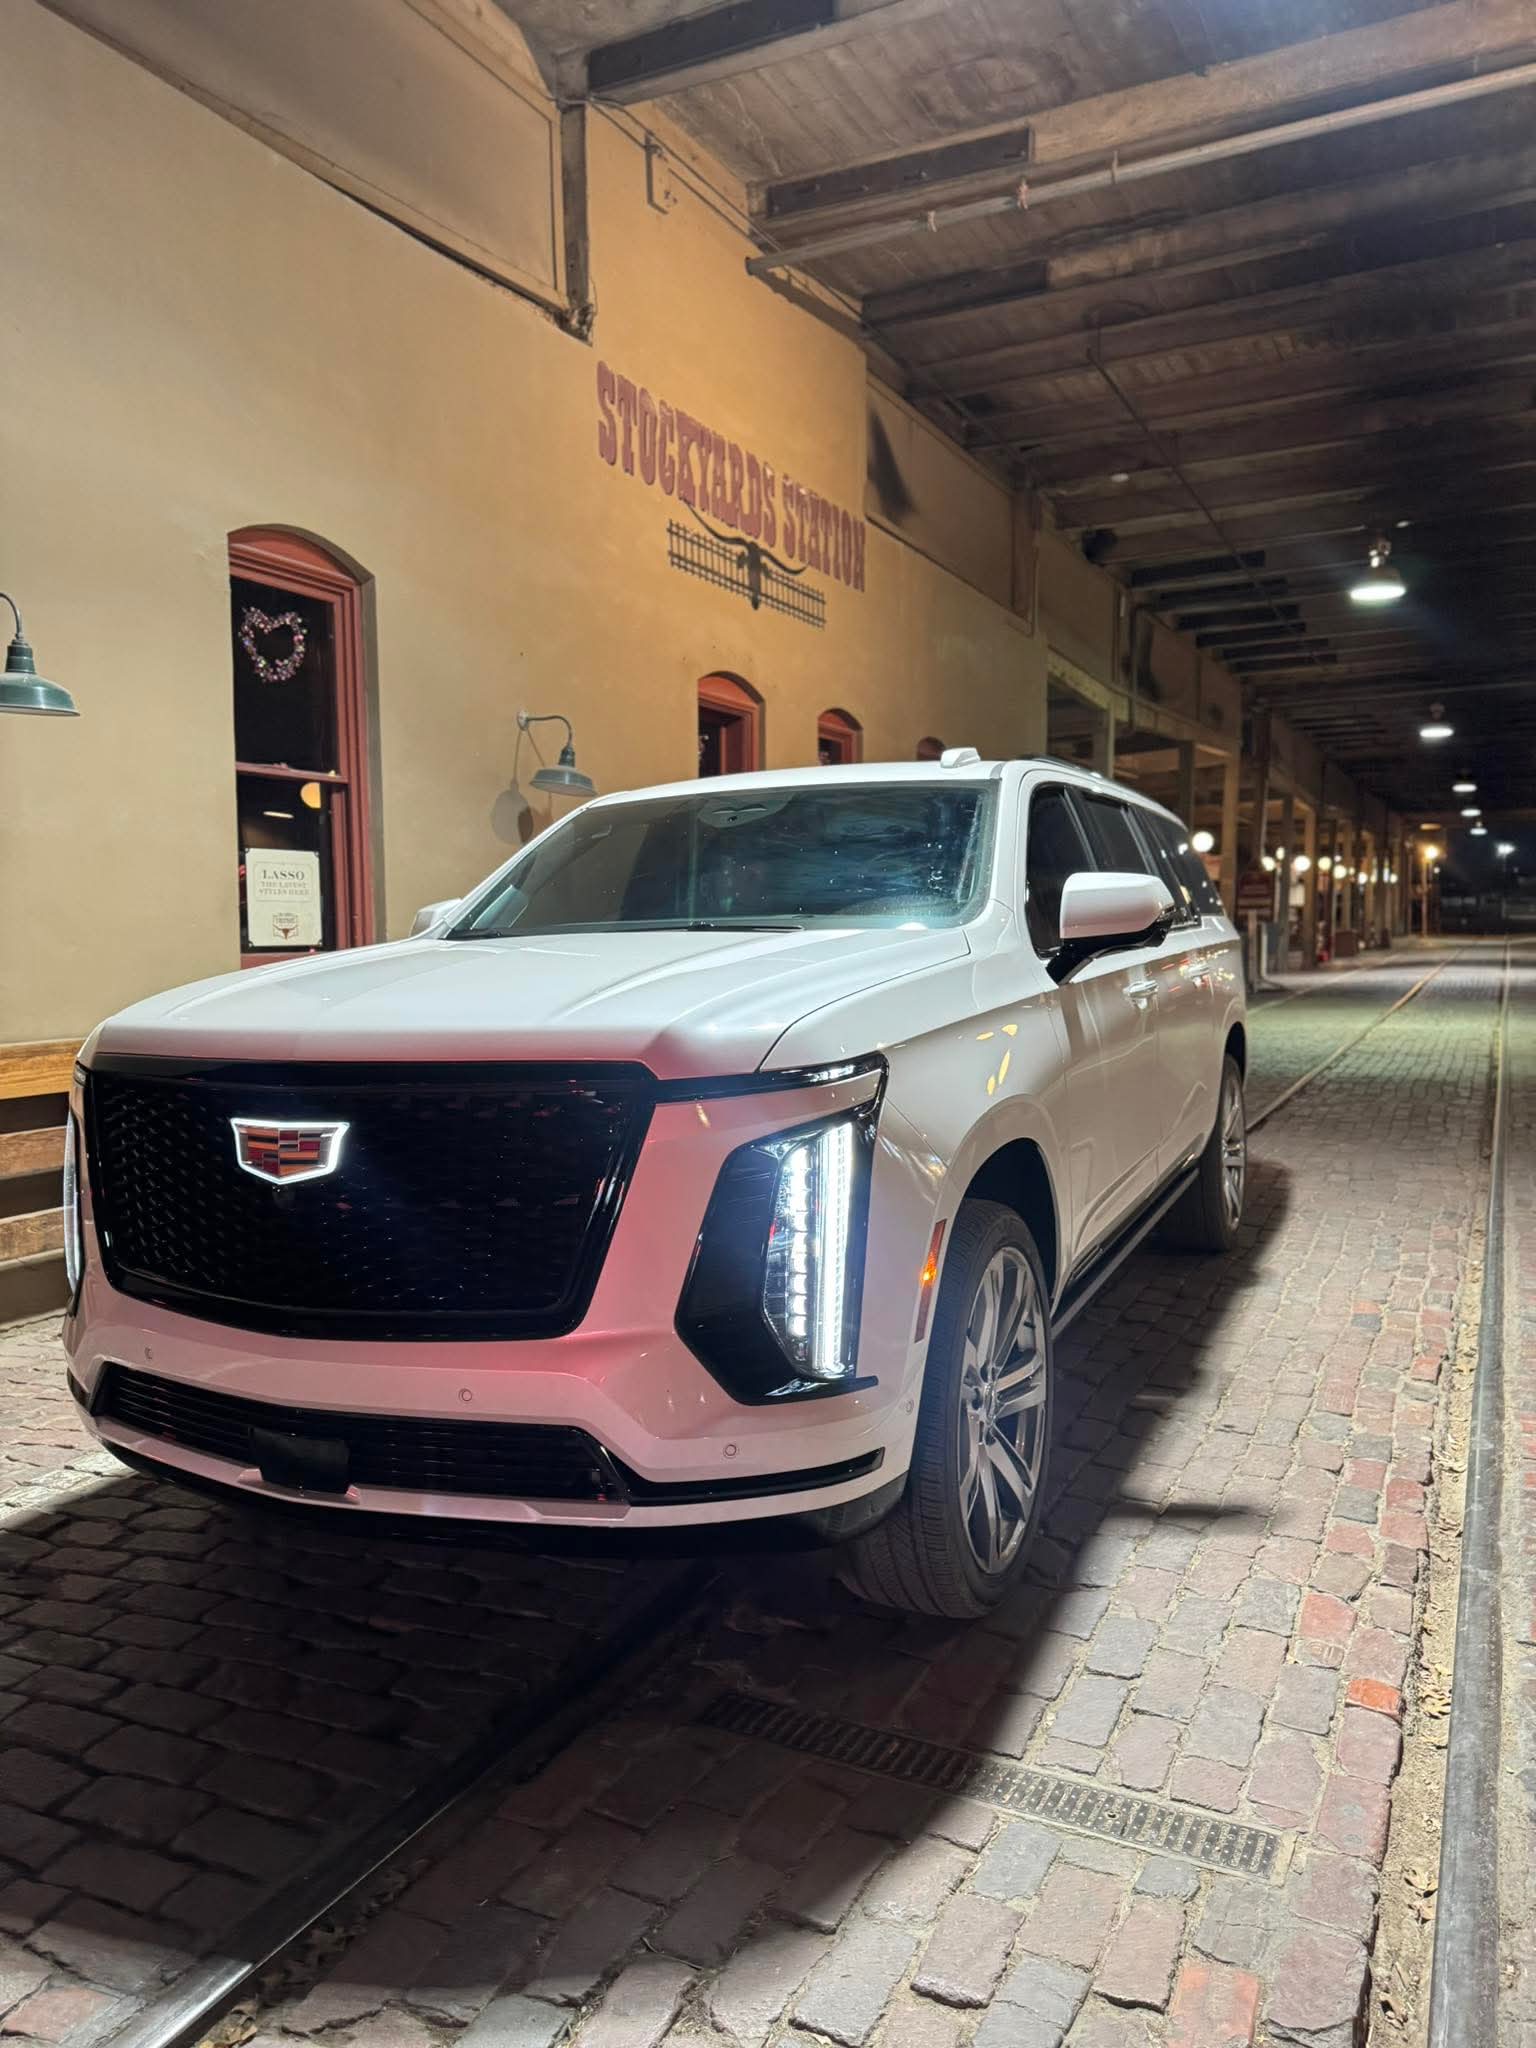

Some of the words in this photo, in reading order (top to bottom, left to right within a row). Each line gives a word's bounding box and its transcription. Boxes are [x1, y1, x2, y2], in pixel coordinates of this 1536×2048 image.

[597, 360, 776, 548] STOCKYARDS
[783, 474, 865, 592] STATION
[262, 869, 305, 880] LASSO
